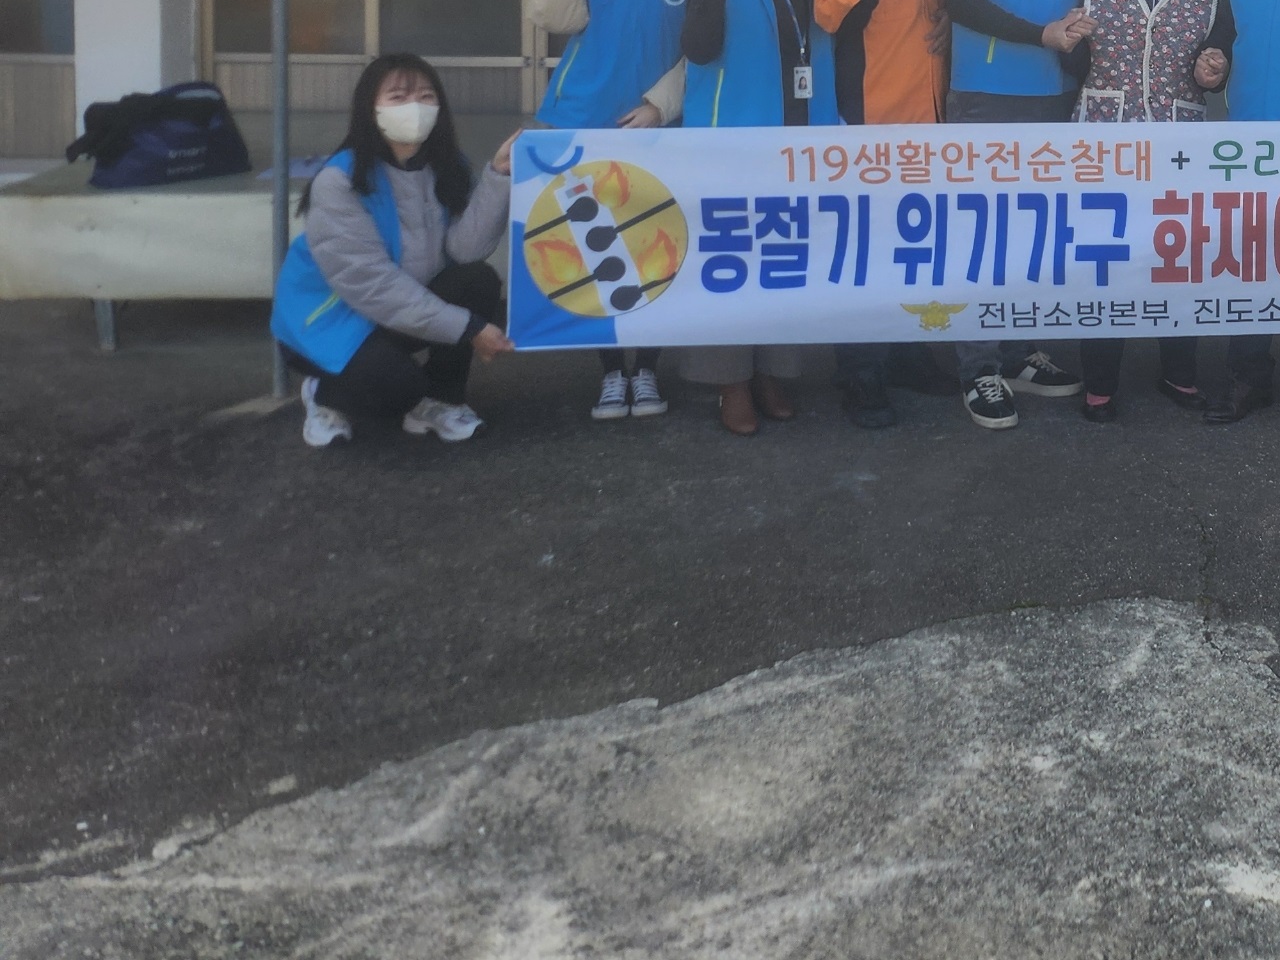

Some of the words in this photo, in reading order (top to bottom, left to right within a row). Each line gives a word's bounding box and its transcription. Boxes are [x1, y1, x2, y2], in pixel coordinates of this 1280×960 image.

[781, 140, 1152, 184] 119생활안전순찰대
[699, 194, 870, 293] 동절기
[894, 193, 1131, 287] 위기가구
[978, 299, 1180, 329] 전남소방본부,
